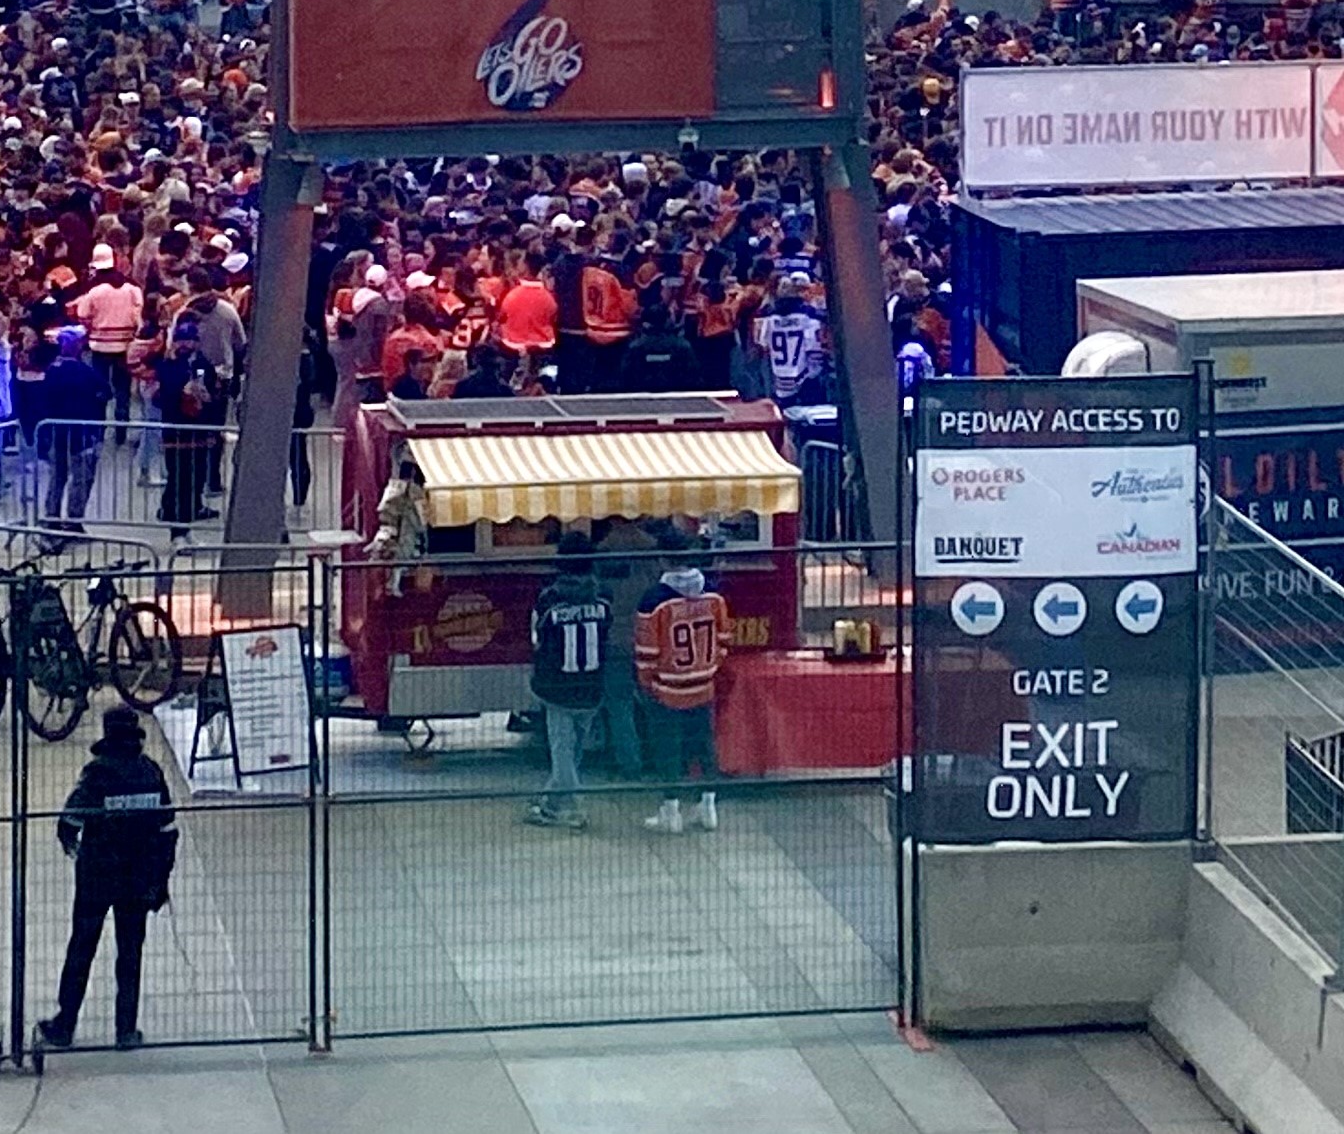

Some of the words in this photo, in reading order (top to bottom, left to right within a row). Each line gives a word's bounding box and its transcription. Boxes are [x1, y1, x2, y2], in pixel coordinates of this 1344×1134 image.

[771, 330, 804, 366] 97
[940, 410, 1042, 435] PEDWAY
[1051, 408, 1143, 433] ACCESS
[1151, 407, 1181, 432] TO
[953, 467, 1026, 484] ROGERS
[954, 486, 1007, 502] PLACE
[934, 535, 1024, 557] BANQUET
[1097, 537, 1181, 555] CANADIAN
[562, 621, 600, 673] 11
[673, 619, 715, 668] 97
[1013, 669, 1085, 695] GATE
[1091, 669, 1110, 694] 2
[1002, 720, 1119, 769] EXIT
[987, 770, 1129, 819] ONLY
